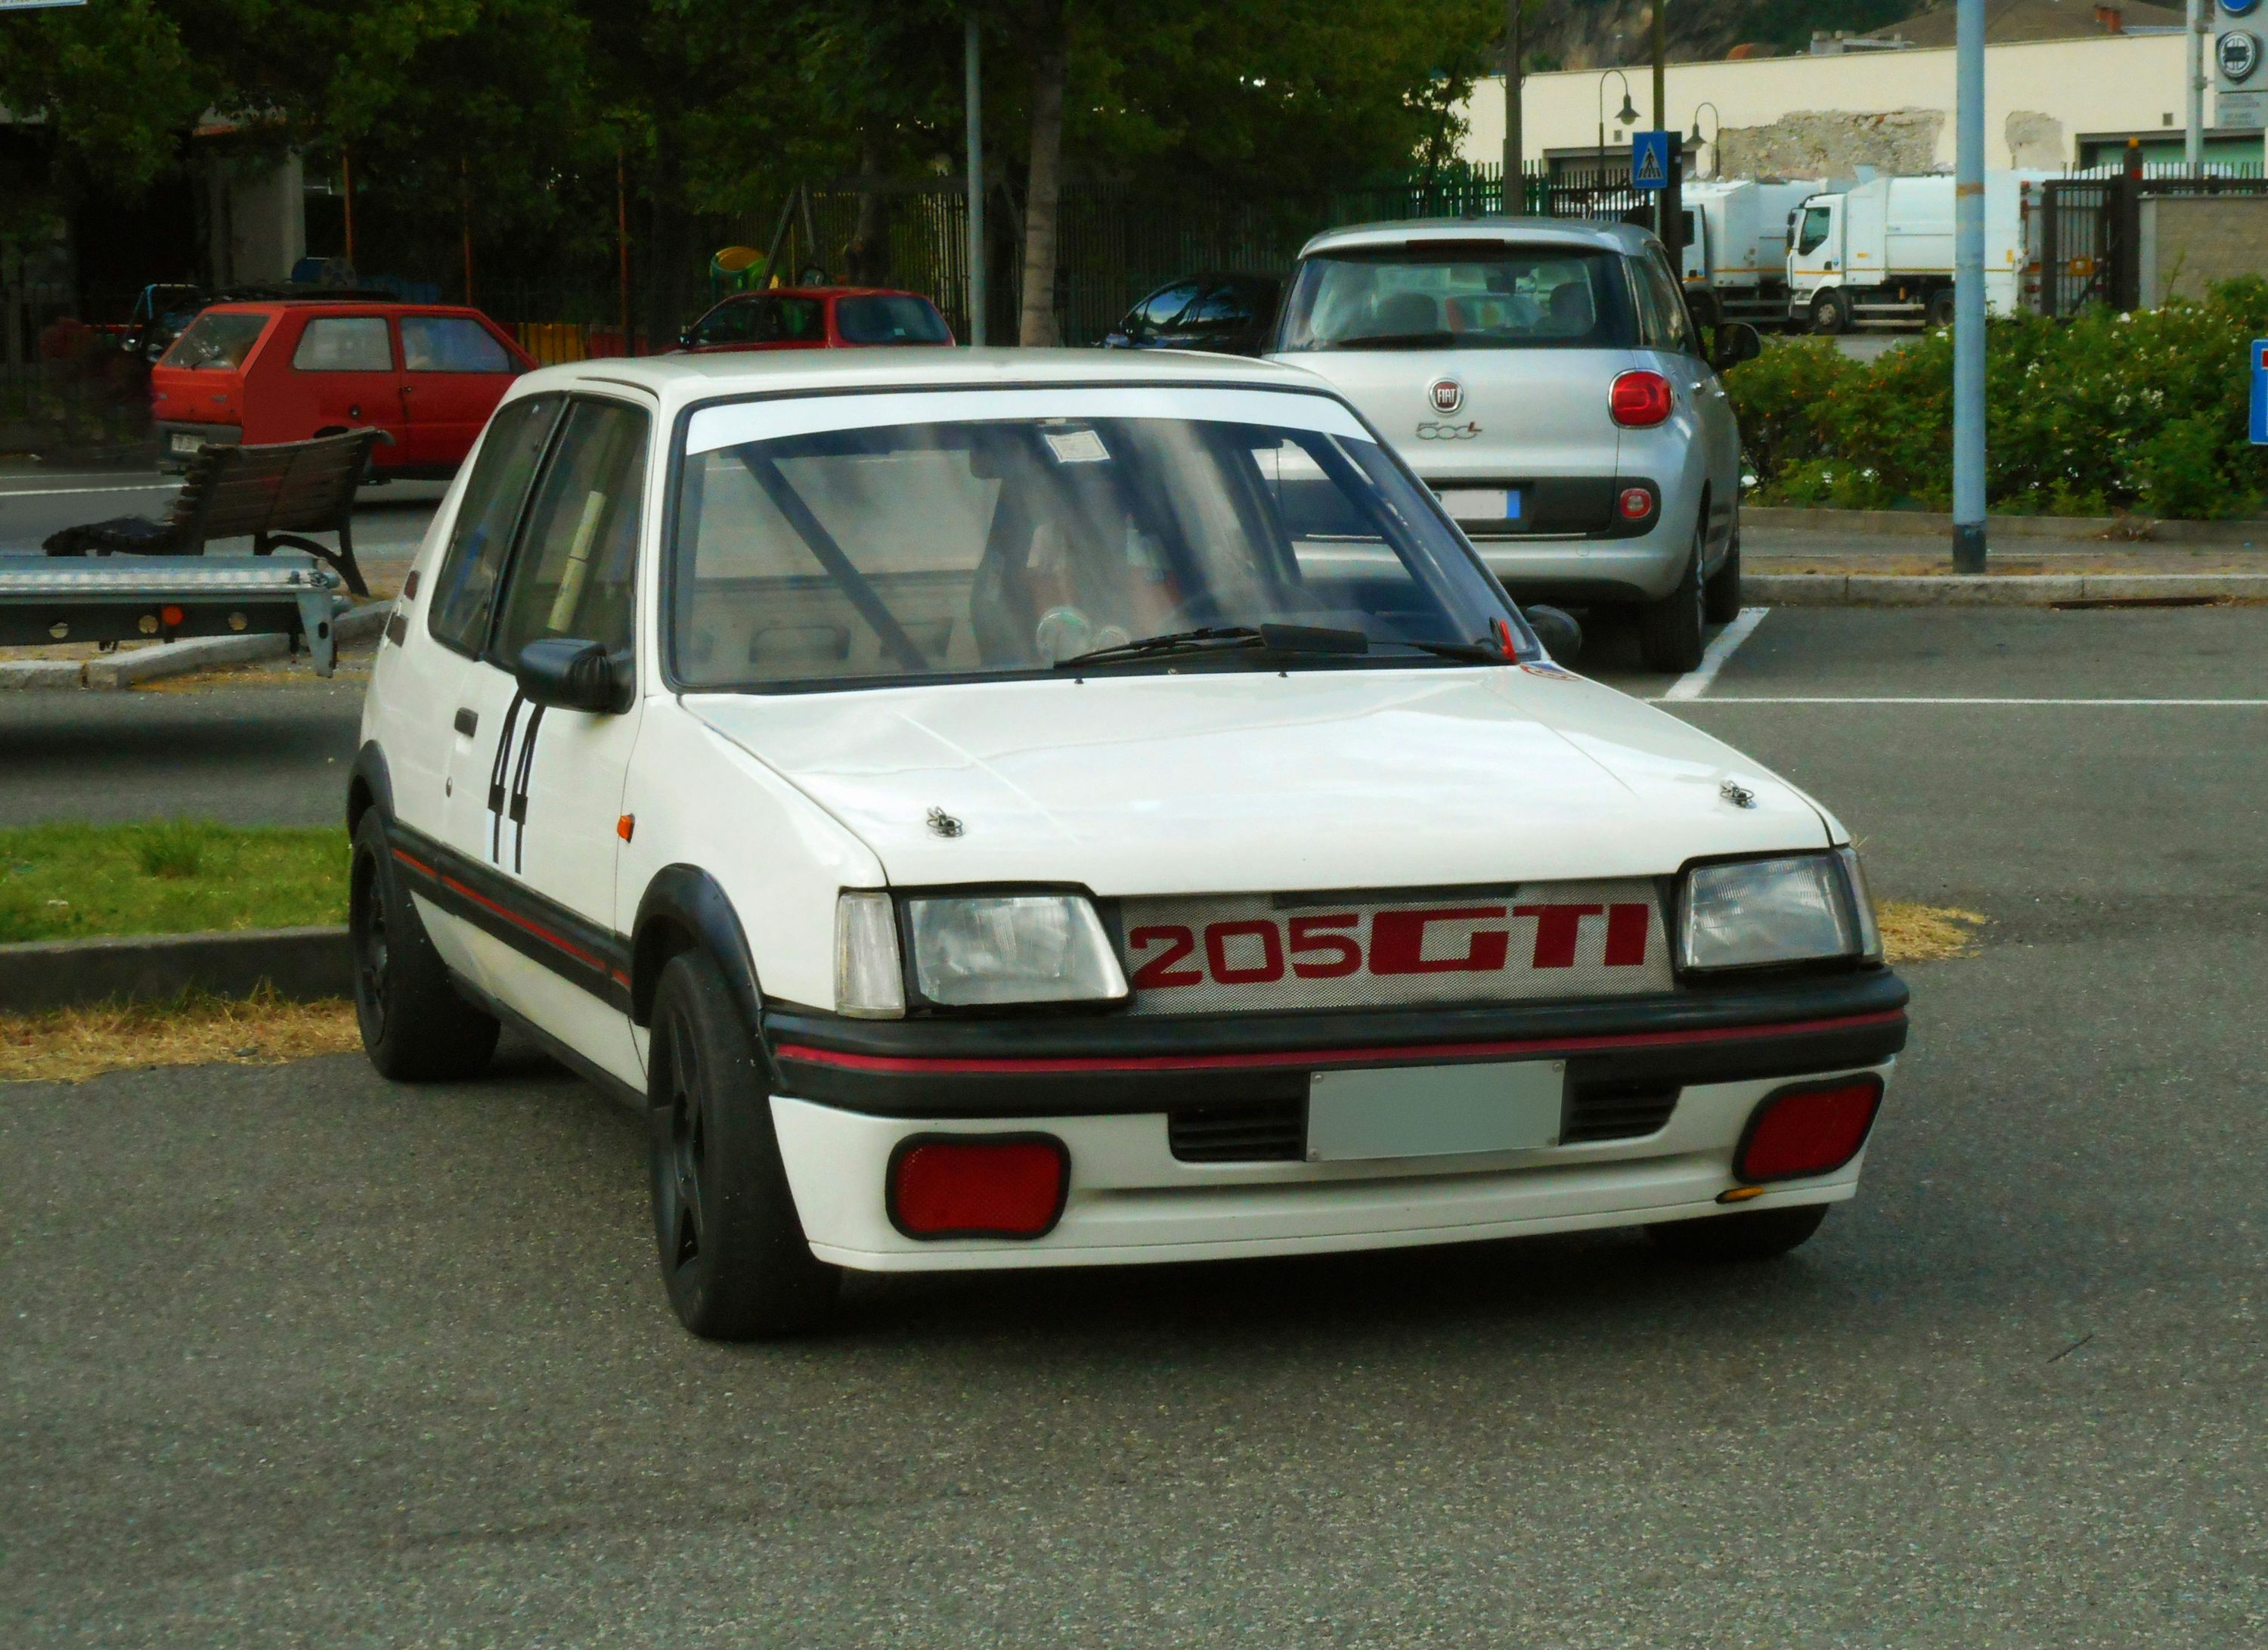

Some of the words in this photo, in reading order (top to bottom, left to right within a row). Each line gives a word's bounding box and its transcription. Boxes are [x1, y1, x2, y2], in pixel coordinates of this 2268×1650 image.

[1436, 388, 1456, 404] FIAT
[1415, 421, 1483, 440] 500L
[1129, 913, 1362, 991] 205
[1368, 903, 1649, 975] GTI
